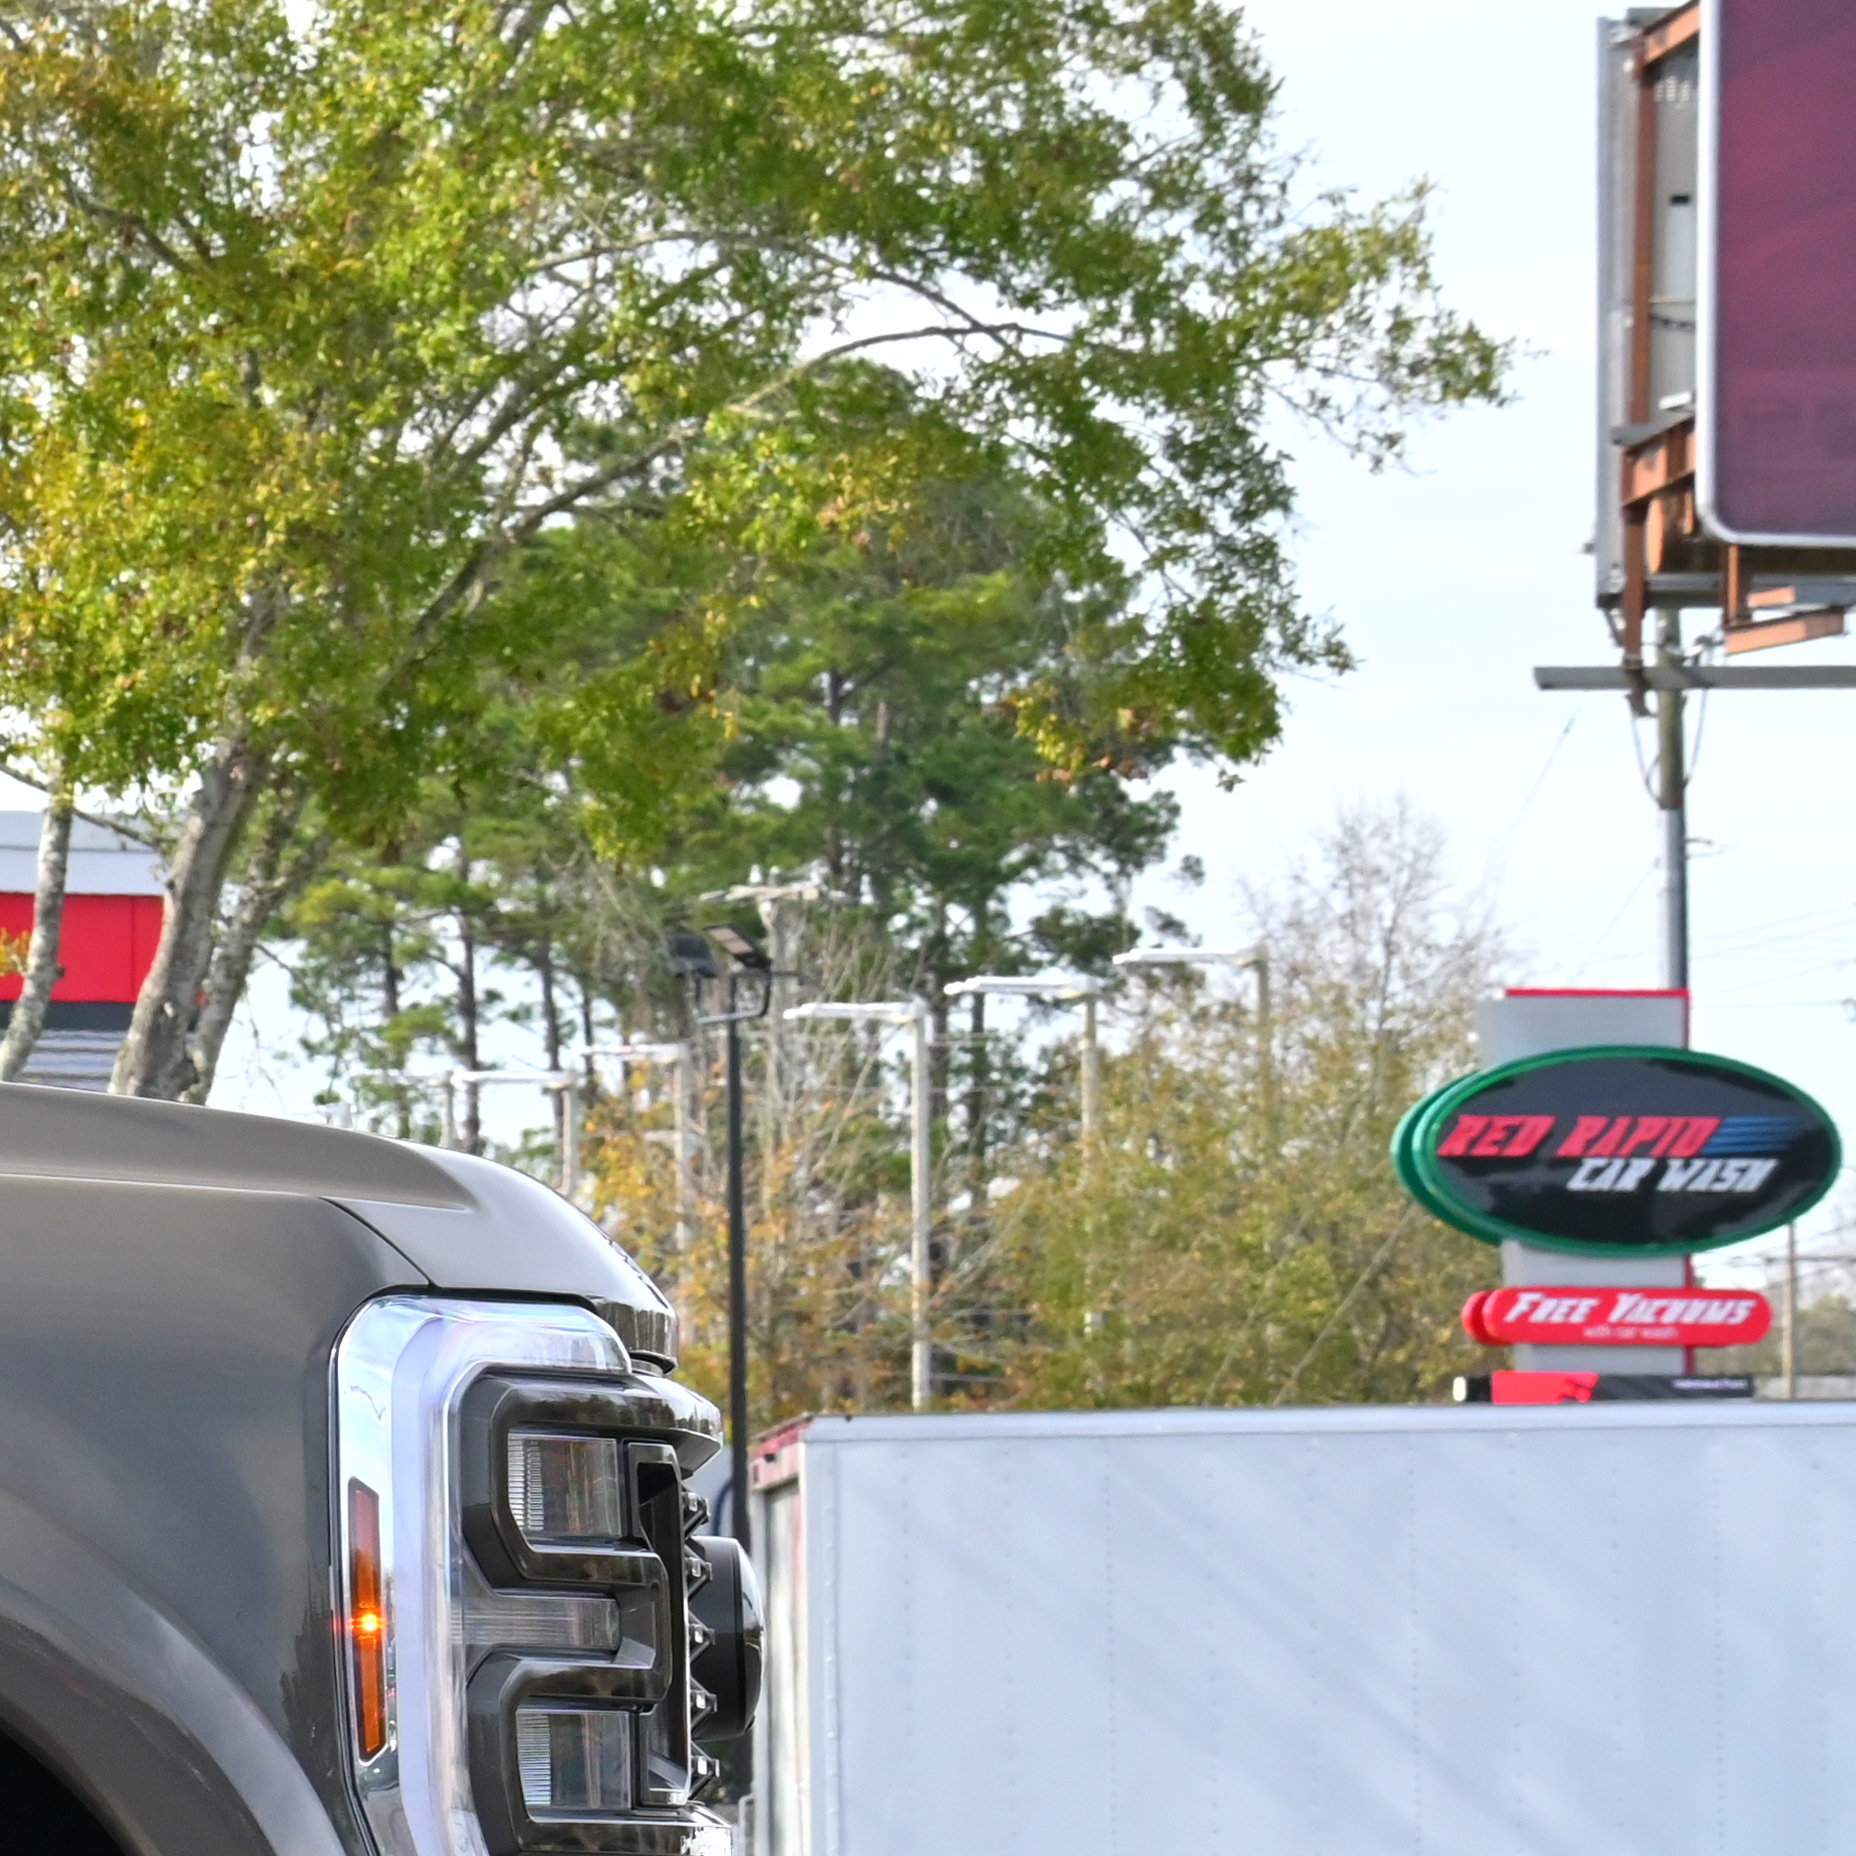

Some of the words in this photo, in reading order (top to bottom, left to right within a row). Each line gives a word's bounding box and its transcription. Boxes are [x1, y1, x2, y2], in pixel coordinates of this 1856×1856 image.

[1437, 1114, 1556, 1157] RED
[1556, 1115, 1722, 1158] RAPID
[1567, 1158, 1655, 1192] CAR
[1656, 1158, 1779, 1193] WASH
